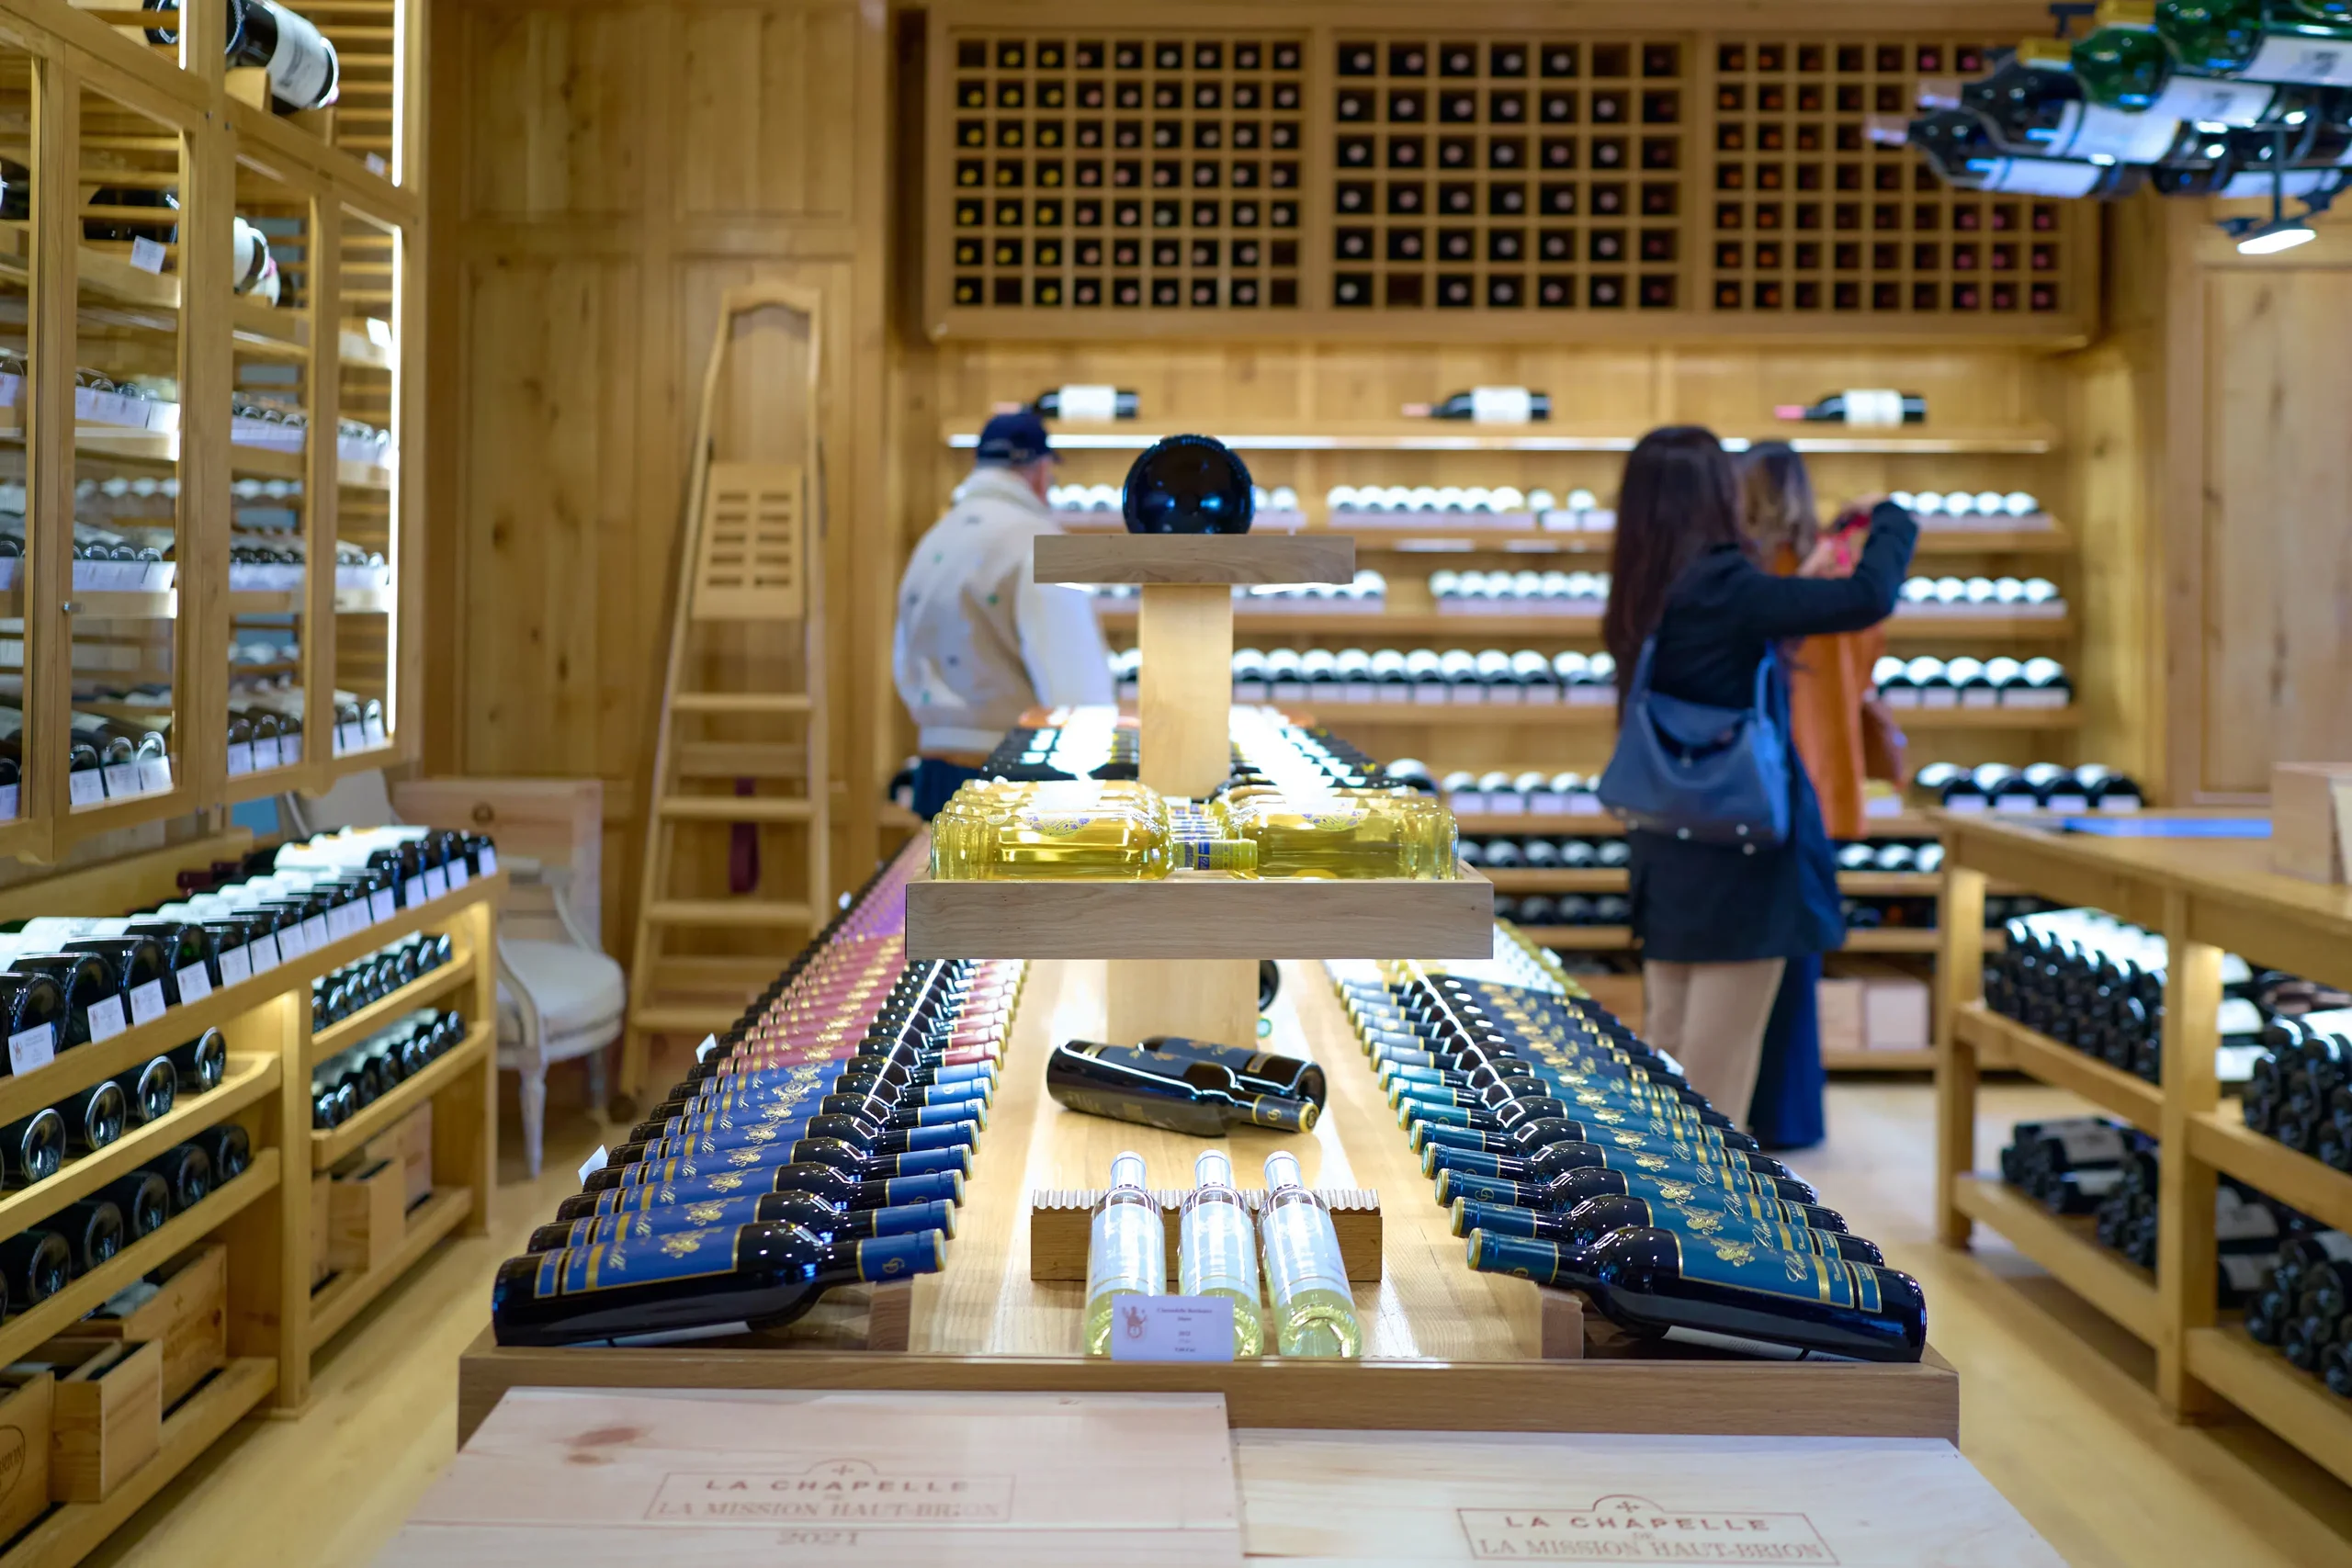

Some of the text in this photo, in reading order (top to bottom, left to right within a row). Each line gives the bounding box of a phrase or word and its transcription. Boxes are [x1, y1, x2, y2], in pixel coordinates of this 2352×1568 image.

[705, 1480, 969, 1494] LA CHAPELLE
[657, 1501, 694, 1516] LA
[705, 1501, 819, 1517] MISSION
[1505, 1516, 1770, 1531] LA CHAPELLE
[776, 1530, 859, 1547] 2021
[1479, 1538, 1518, 1555] LA
[1525, 1539, 1642, 1557] MISSION
